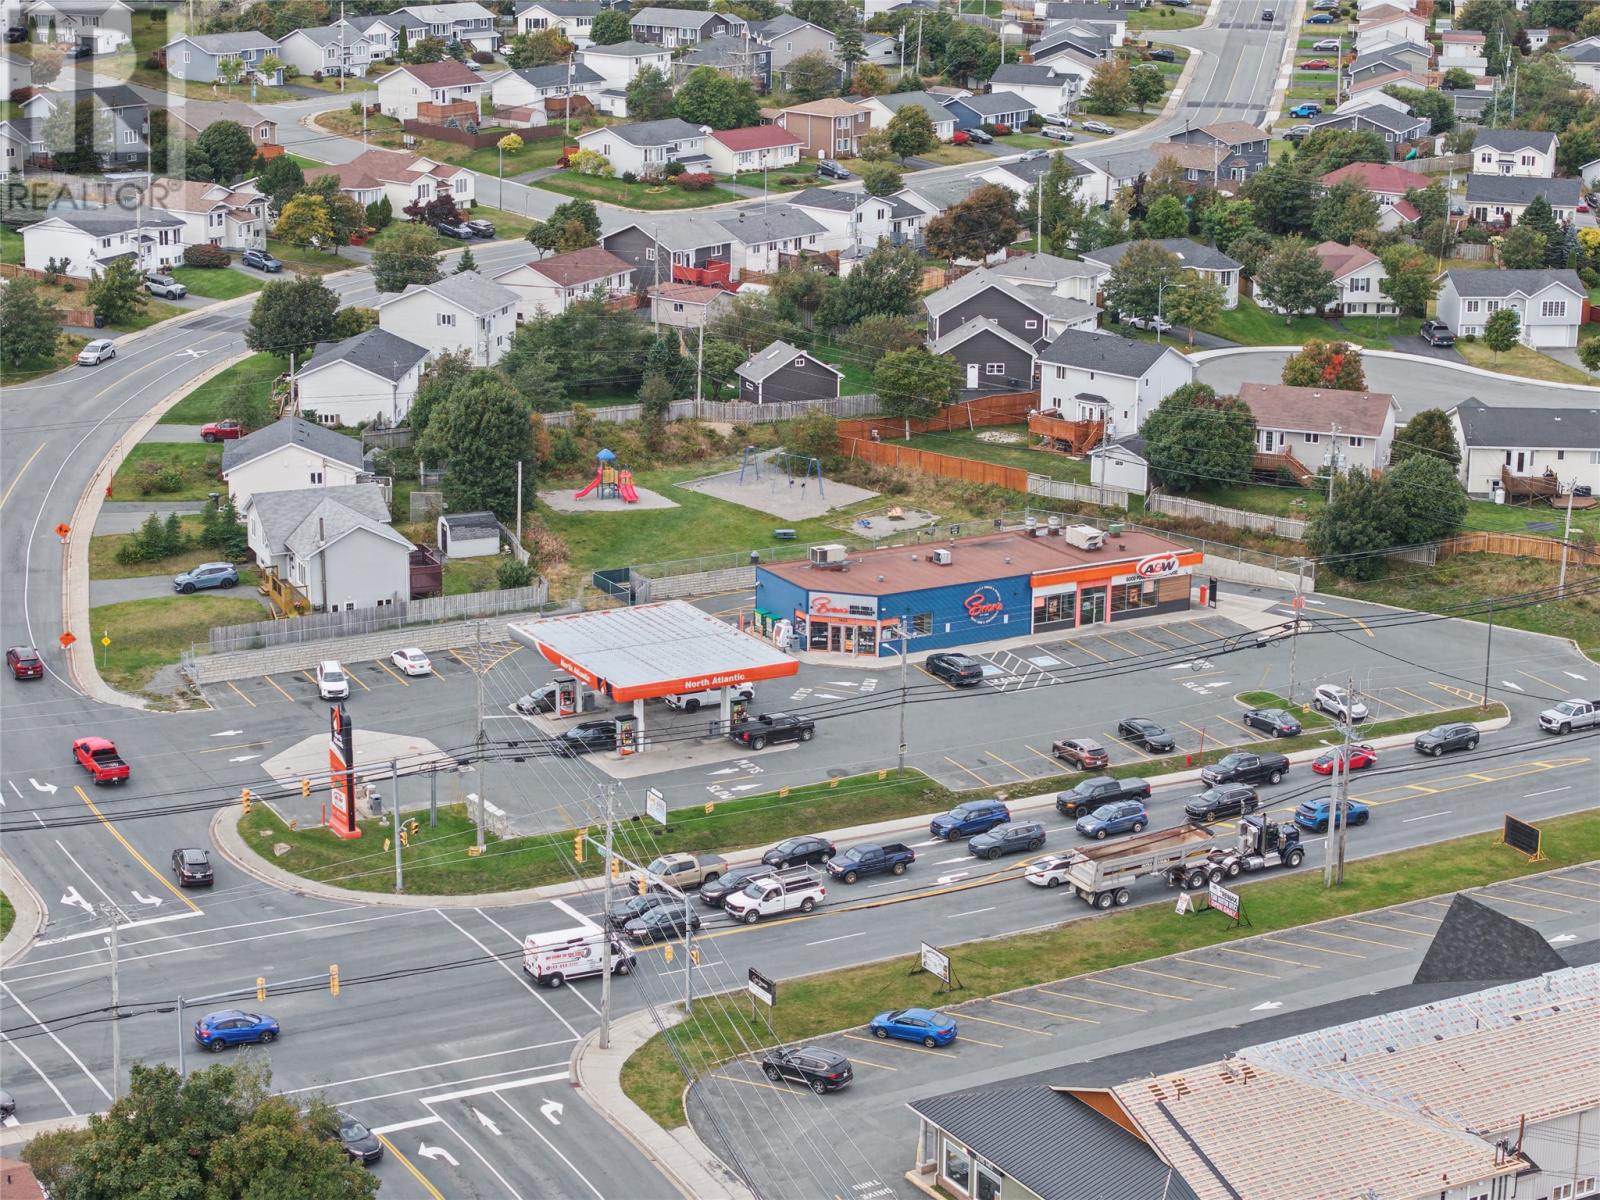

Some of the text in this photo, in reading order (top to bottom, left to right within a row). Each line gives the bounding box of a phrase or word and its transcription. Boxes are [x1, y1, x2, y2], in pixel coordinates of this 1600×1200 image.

[1144, 560, 1176, 574] A&W
[684, 673, 745, 689] North Atlantic
[852, 1179, 882, 1191] THRU
[859, 1187, 893, 1199] DRIVE
